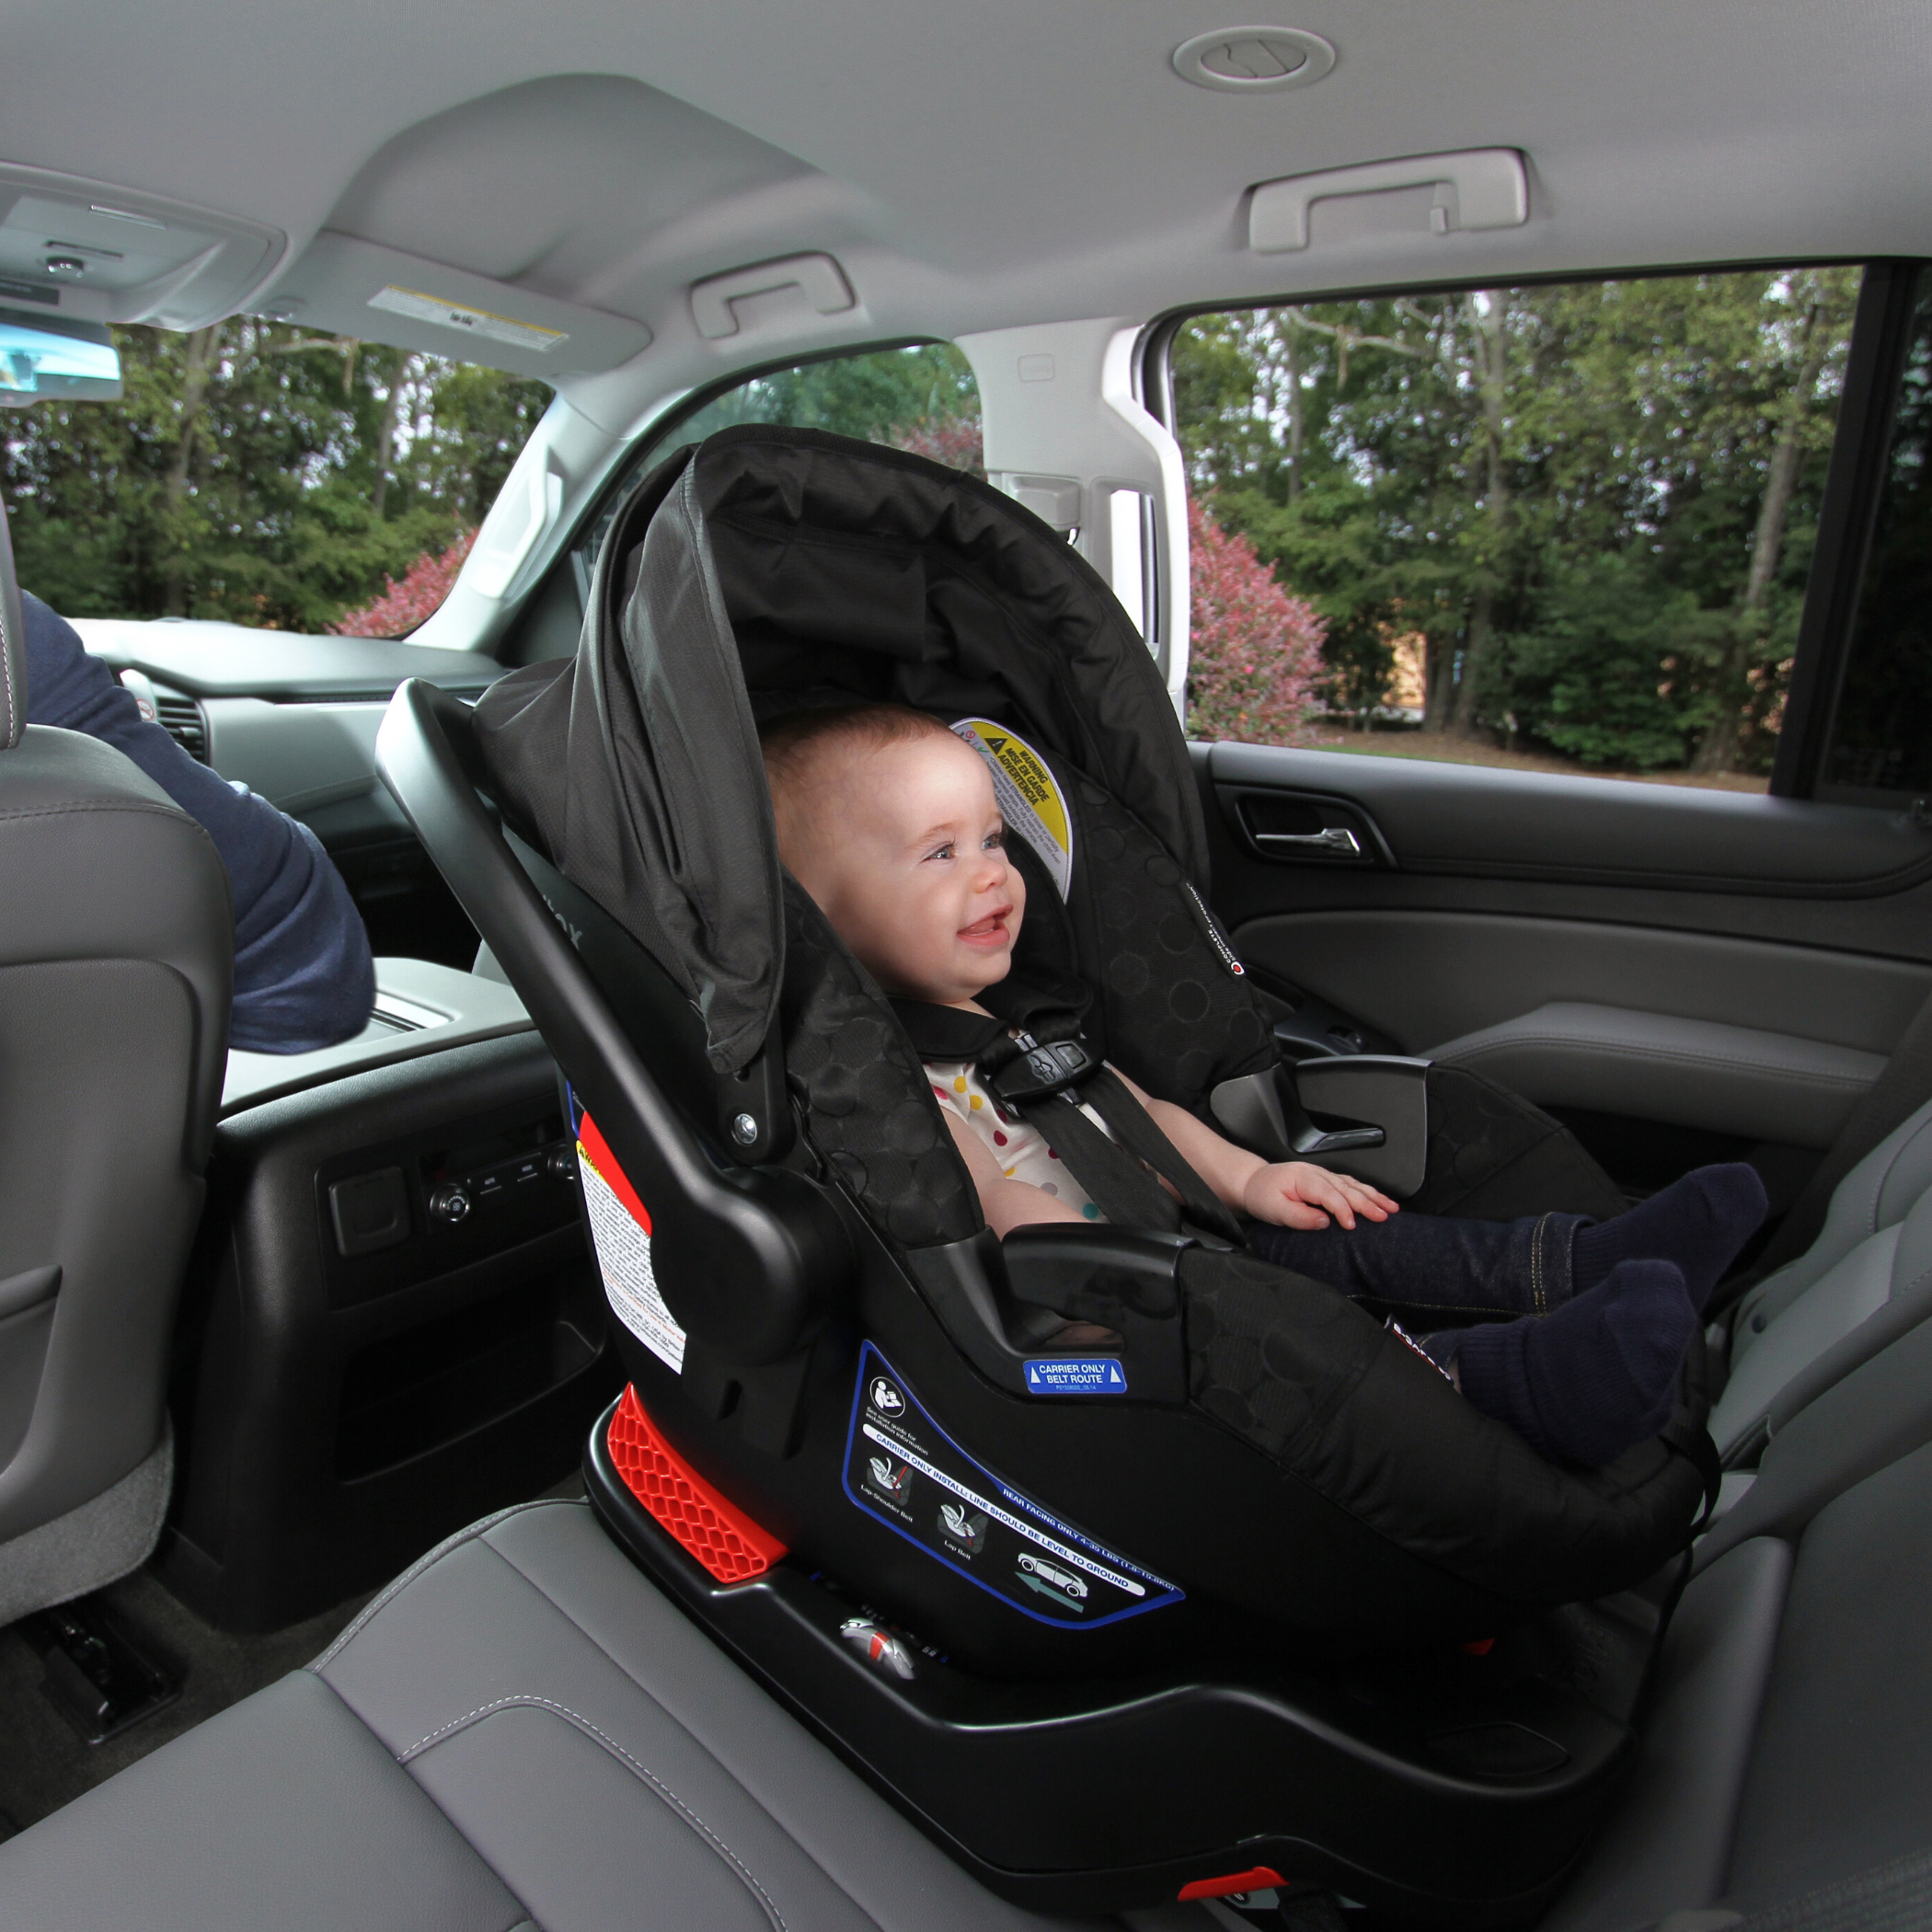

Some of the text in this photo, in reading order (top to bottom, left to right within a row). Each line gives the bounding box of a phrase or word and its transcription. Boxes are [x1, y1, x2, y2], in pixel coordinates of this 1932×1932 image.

[997, 754, 1039, 805] ADVERTENCIA
[1005, 748, 1050, 802] MISE EN GARDE
[1019, 750, 1048, 784] WARNING
[1001, 794, 1010, 805] used
[1008, 804, 1020, 821] outside
[1010, 784, 1031, 813] STRANGLED
[1033, 818, 1043, 830] loose
[1045, 834, 1059, 853] partially
[1018, 807, 1028, 819] Fully
[1043, 842, 1053, 853] child
[1208, 929, 1231, 963] COMPLETE
[1209, 924, 1225, 947] impact
[1225, 947, 1236, 961] side
[1039, 1364, 1105, 1374] CARRIER ONLY
[1046, 1374, 1103, 1384] BELT ROUTE
[866, 1407, 916, 1442] See user guide for
[895, 1431, 928, 1455] information
[860, 1484, 914, 1523] Lap-Shoulder Belt
[876, 1433, 1129, 1588] CARRIER ONLY INSTALL: LINE SHOULD BE LEVEL TO GROUND
[1003, 1488, 1025, 1507] REAR
[1026, 1502, 1056, 1526] FACING
[1057, 1523, 1079, 1539] ONLY
[1101, 1549, 1119, 1563] LBS
[944, 1539, 971, 1561] Lap Belt
